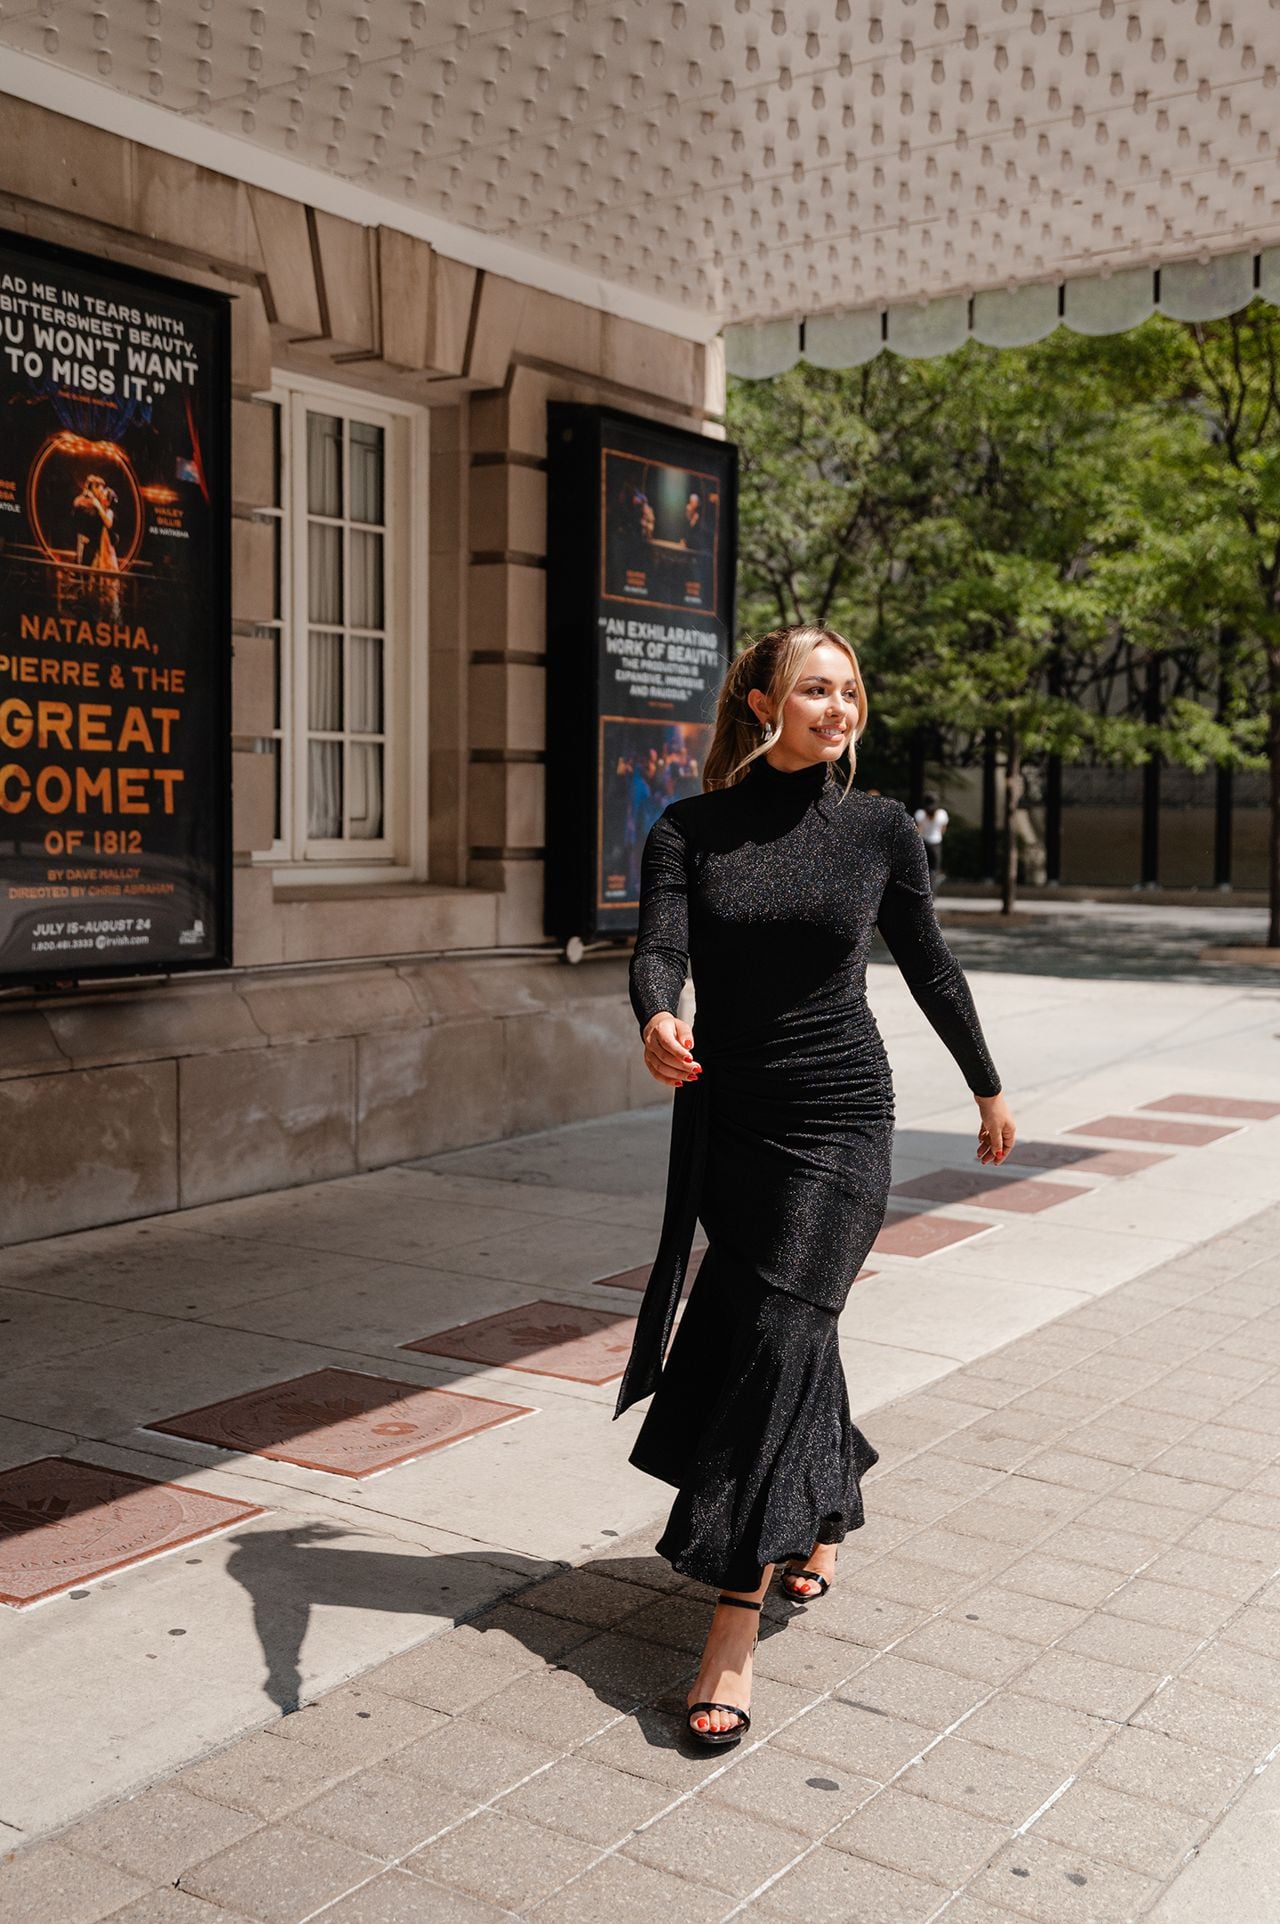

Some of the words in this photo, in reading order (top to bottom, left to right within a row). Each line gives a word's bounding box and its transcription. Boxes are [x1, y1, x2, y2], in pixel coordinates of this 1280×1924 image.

[32, 282, 57, 303] ME
[62, 289, 79, 309] IN
[84, 296, 142, 325] TEARS
[145, 311, 185, 336] WITH
[0, 296, 124, 340] BITTERSWEET
[129, 328, 198, 359] BEAUTY.
[0, 316, 24, 344] U
[33, 323, 120, 366] WON'T
[128, 346, 199, 386] WANT
[4, 346, 44, 378] TO
[52, 357, 115, 395] MISS
[123, 374, 166, 404] IT."
[20, 614, 159, 655] NATASHA,
[606, 636, 645, 657] WORK
[646, 641, 666, 659] OF
[627, 620, 718, 650] EXHILARATING
[0, 655, 100, 687] PIERRE
[109, 664, 125, 689] &
[131, 665, 186, 693] THE
[621, 657, 639, 670] THE
[629, 684, 649, 697] AND
[0, 698, 181, 754] GREAT
[0, 763, 184, 814] COMET
[44, 830, 84, 855] OF
[94, 830, 143, 855] 1812
[47, 869, 63, 881] BY
[66, 868, 98, 881] DAVE
[9, 885, 69, 899] DIRECTED
[71, 885, 86, 897] BY
[33, 922, 65, 937] JULY
[135, 918, 151, 931] 24
